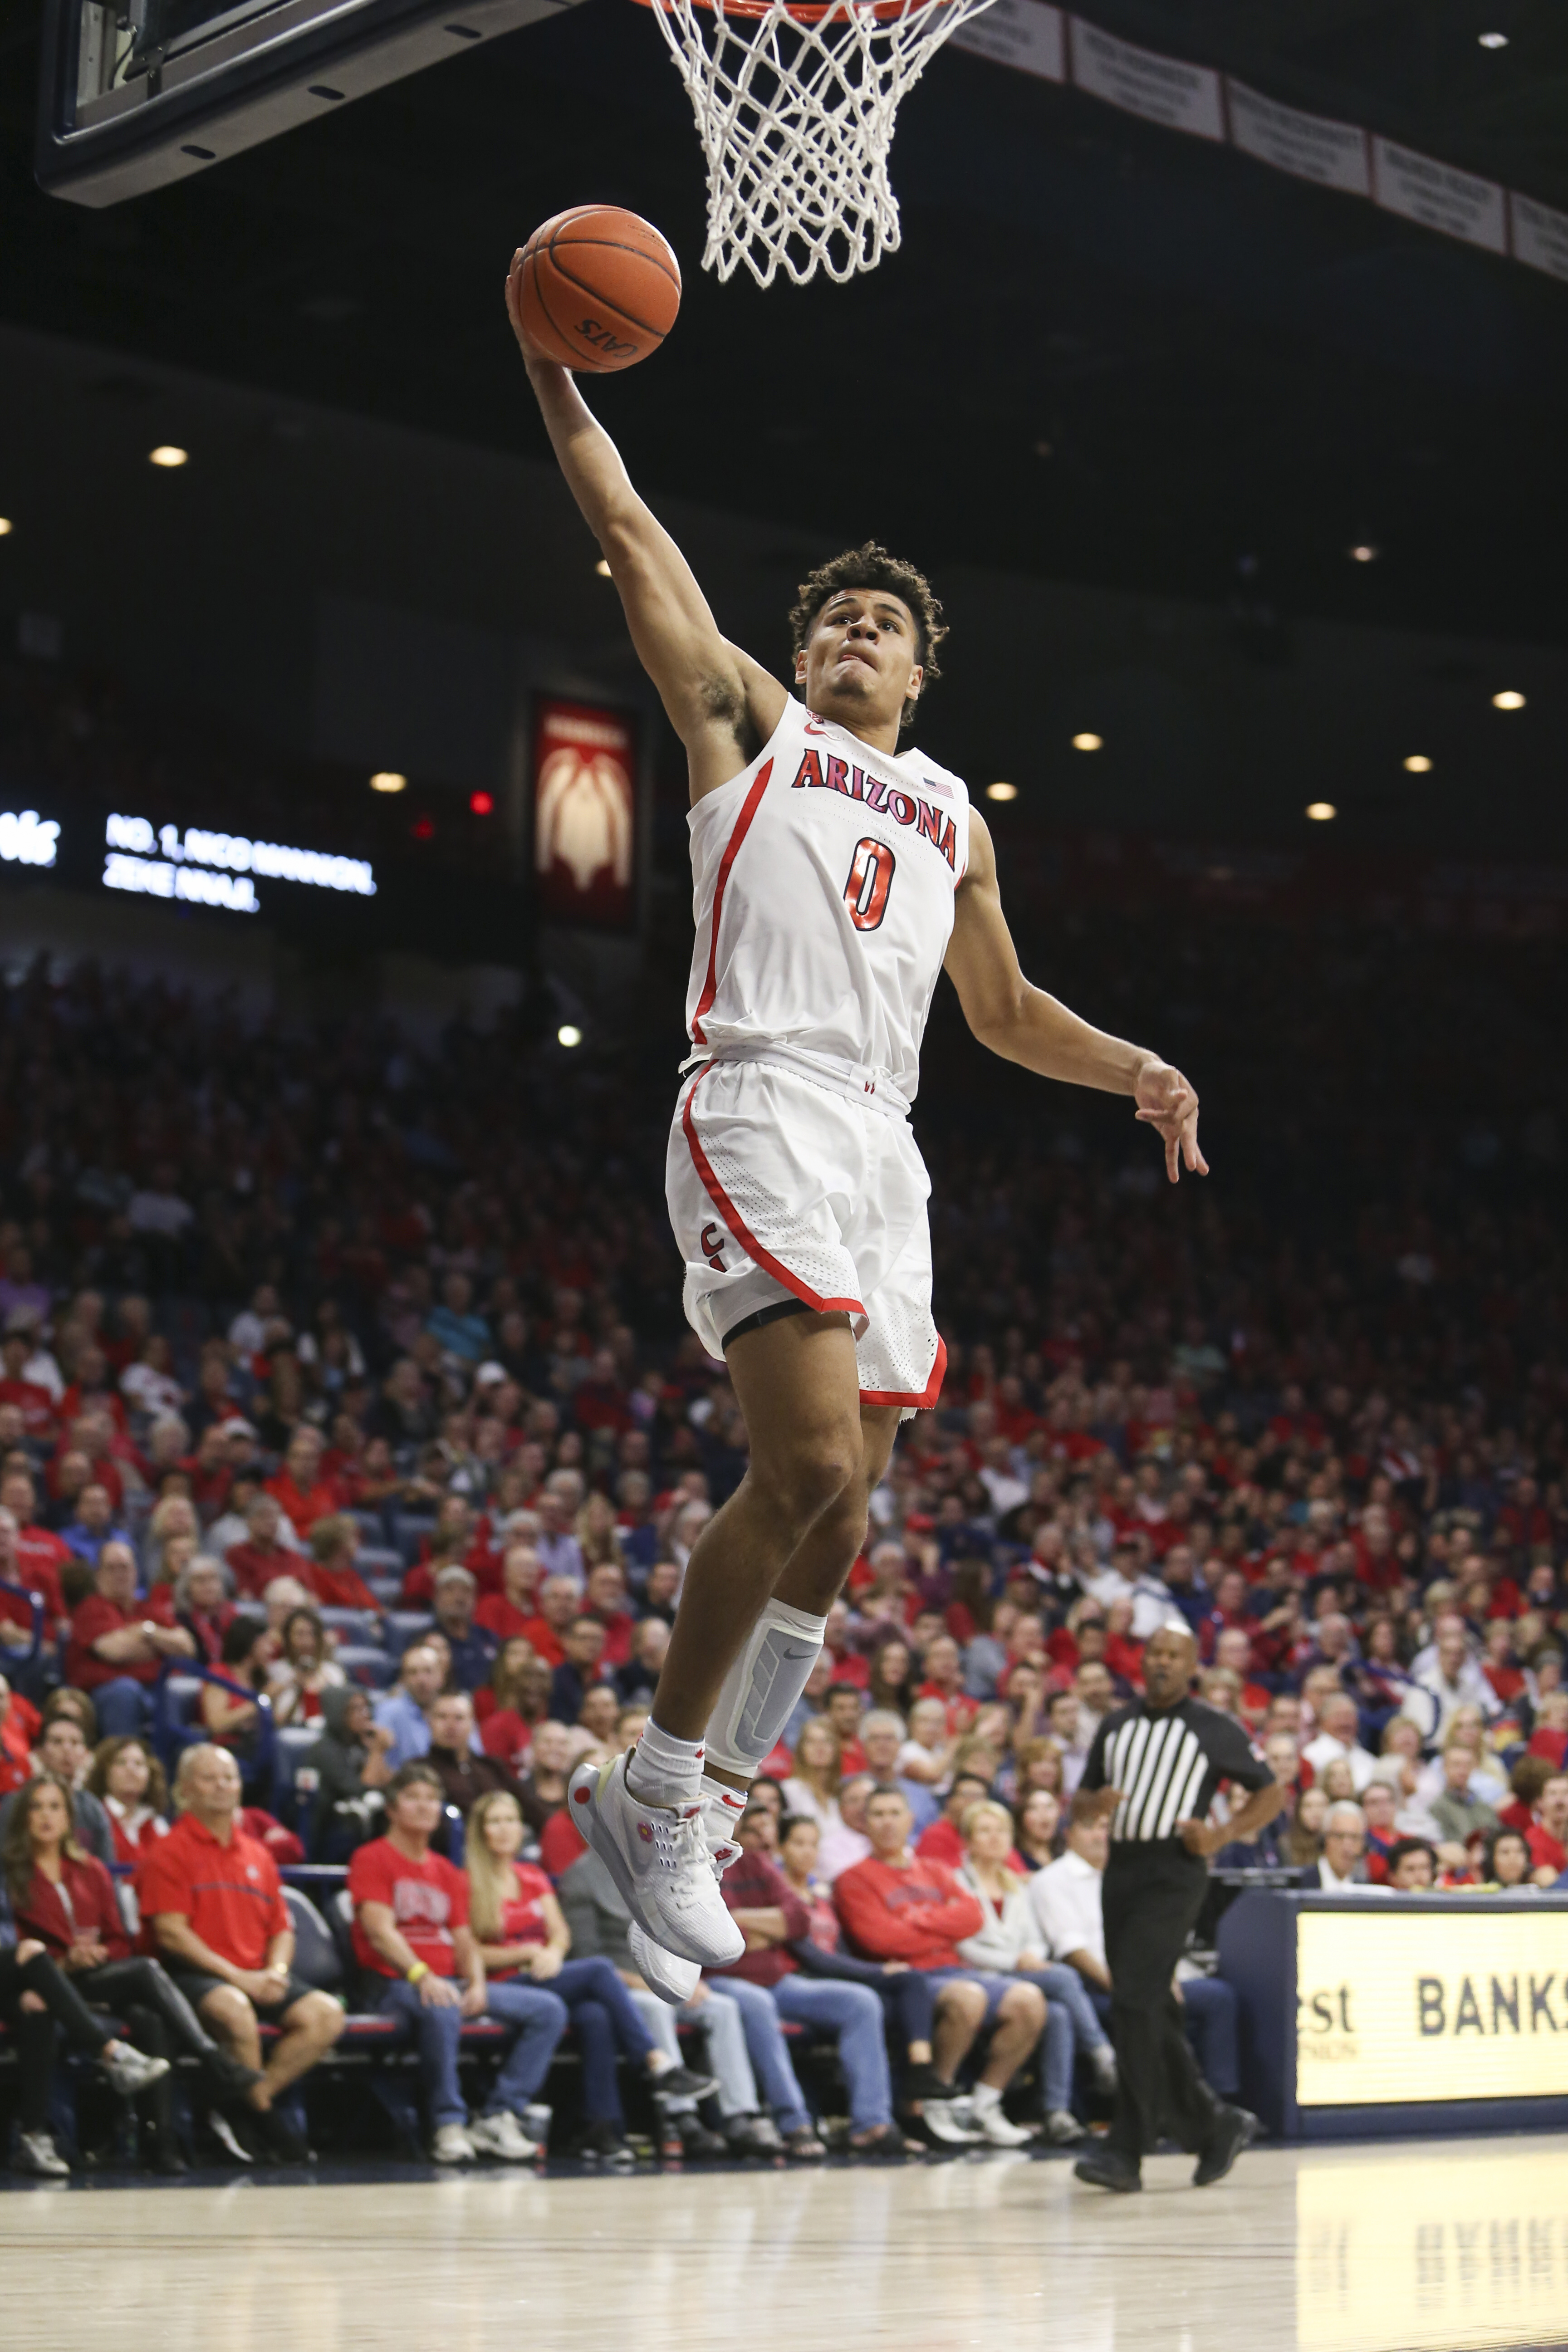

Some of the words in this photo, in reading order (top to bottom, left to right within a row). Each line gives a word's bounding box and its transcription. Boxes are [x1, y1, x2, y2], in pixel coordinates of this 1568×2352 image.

[573, 319, 638, 358] CATS
[791, 748, 956, 872] ARIZONA
[843, 837, 896, 931] 0
[1419, 1975, 1568, 2036] BANK
